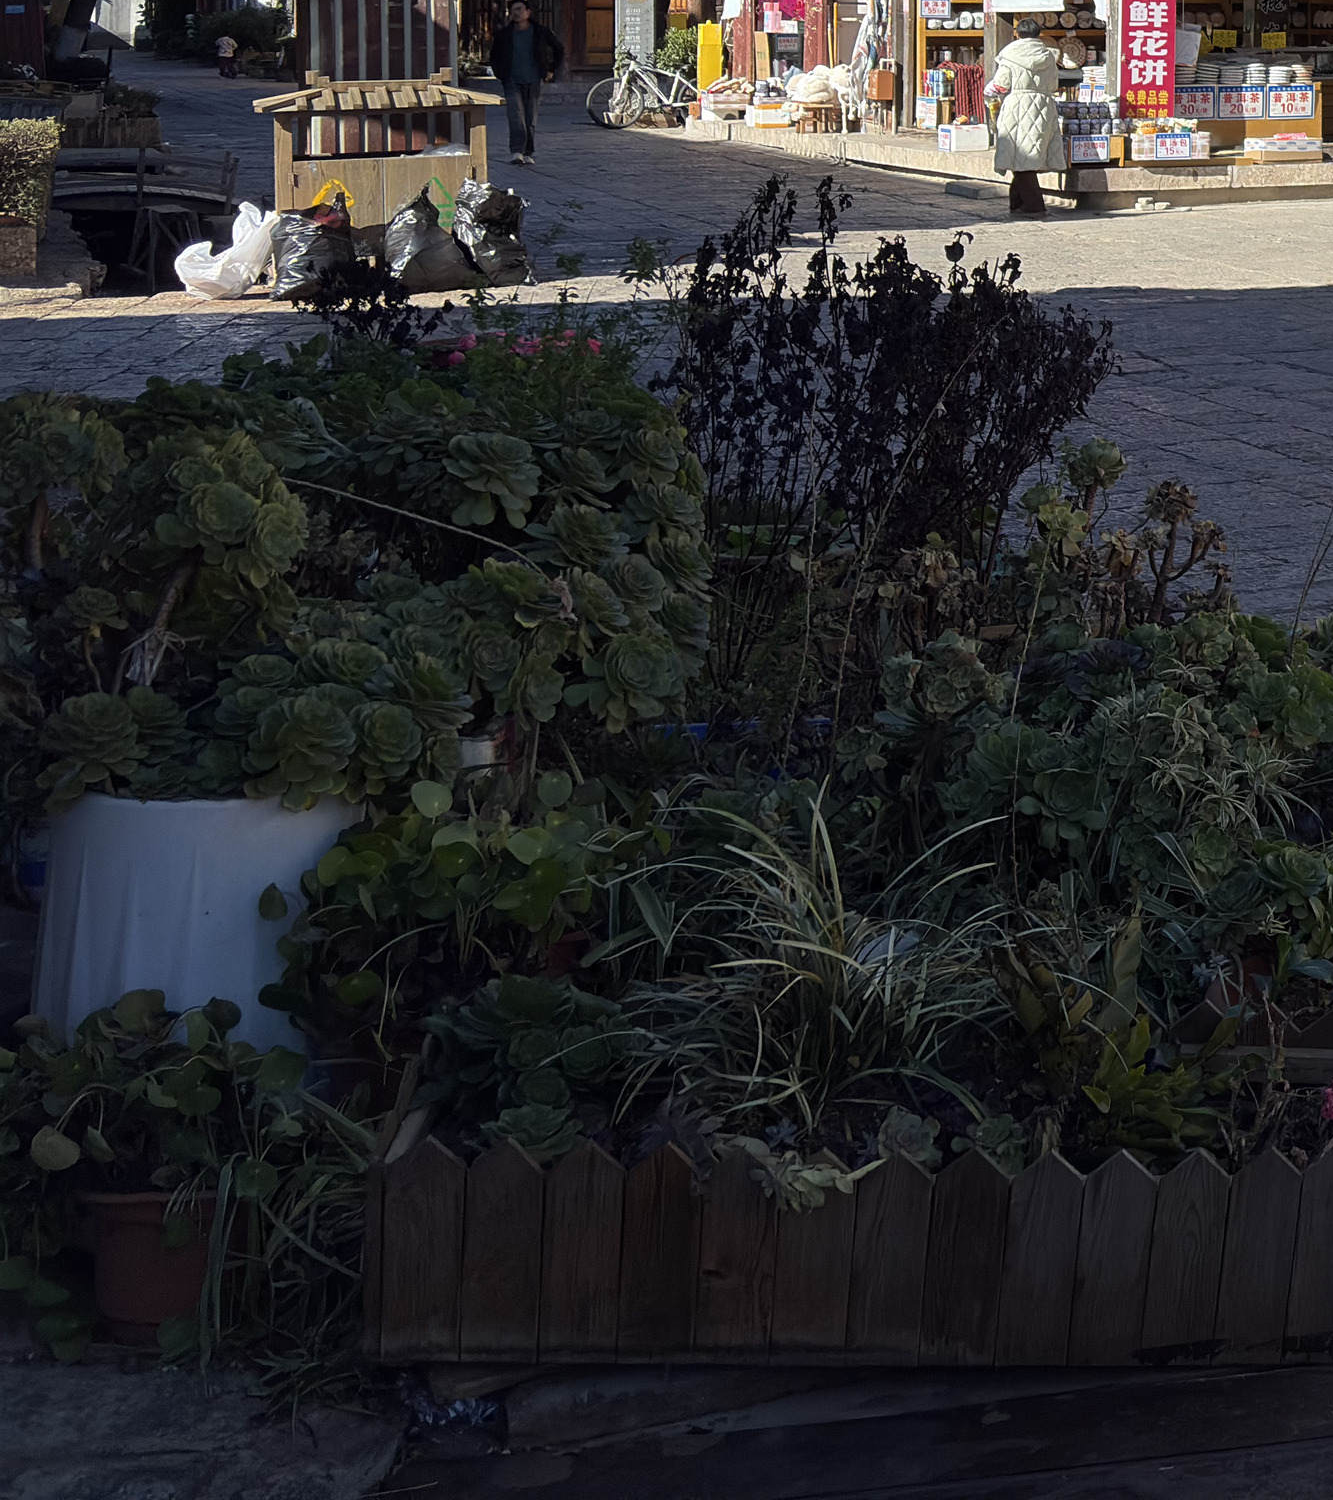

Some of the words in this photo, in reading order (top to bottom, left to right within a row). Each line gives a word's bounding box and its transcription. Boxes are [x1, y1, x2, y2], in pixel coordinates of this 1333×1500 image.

[1125, 90, 1169, 105] 免费品尝
[1223, 92, 1260, 104] 普洱茶
[1272, 92, 1310, 103] 普洱茶
